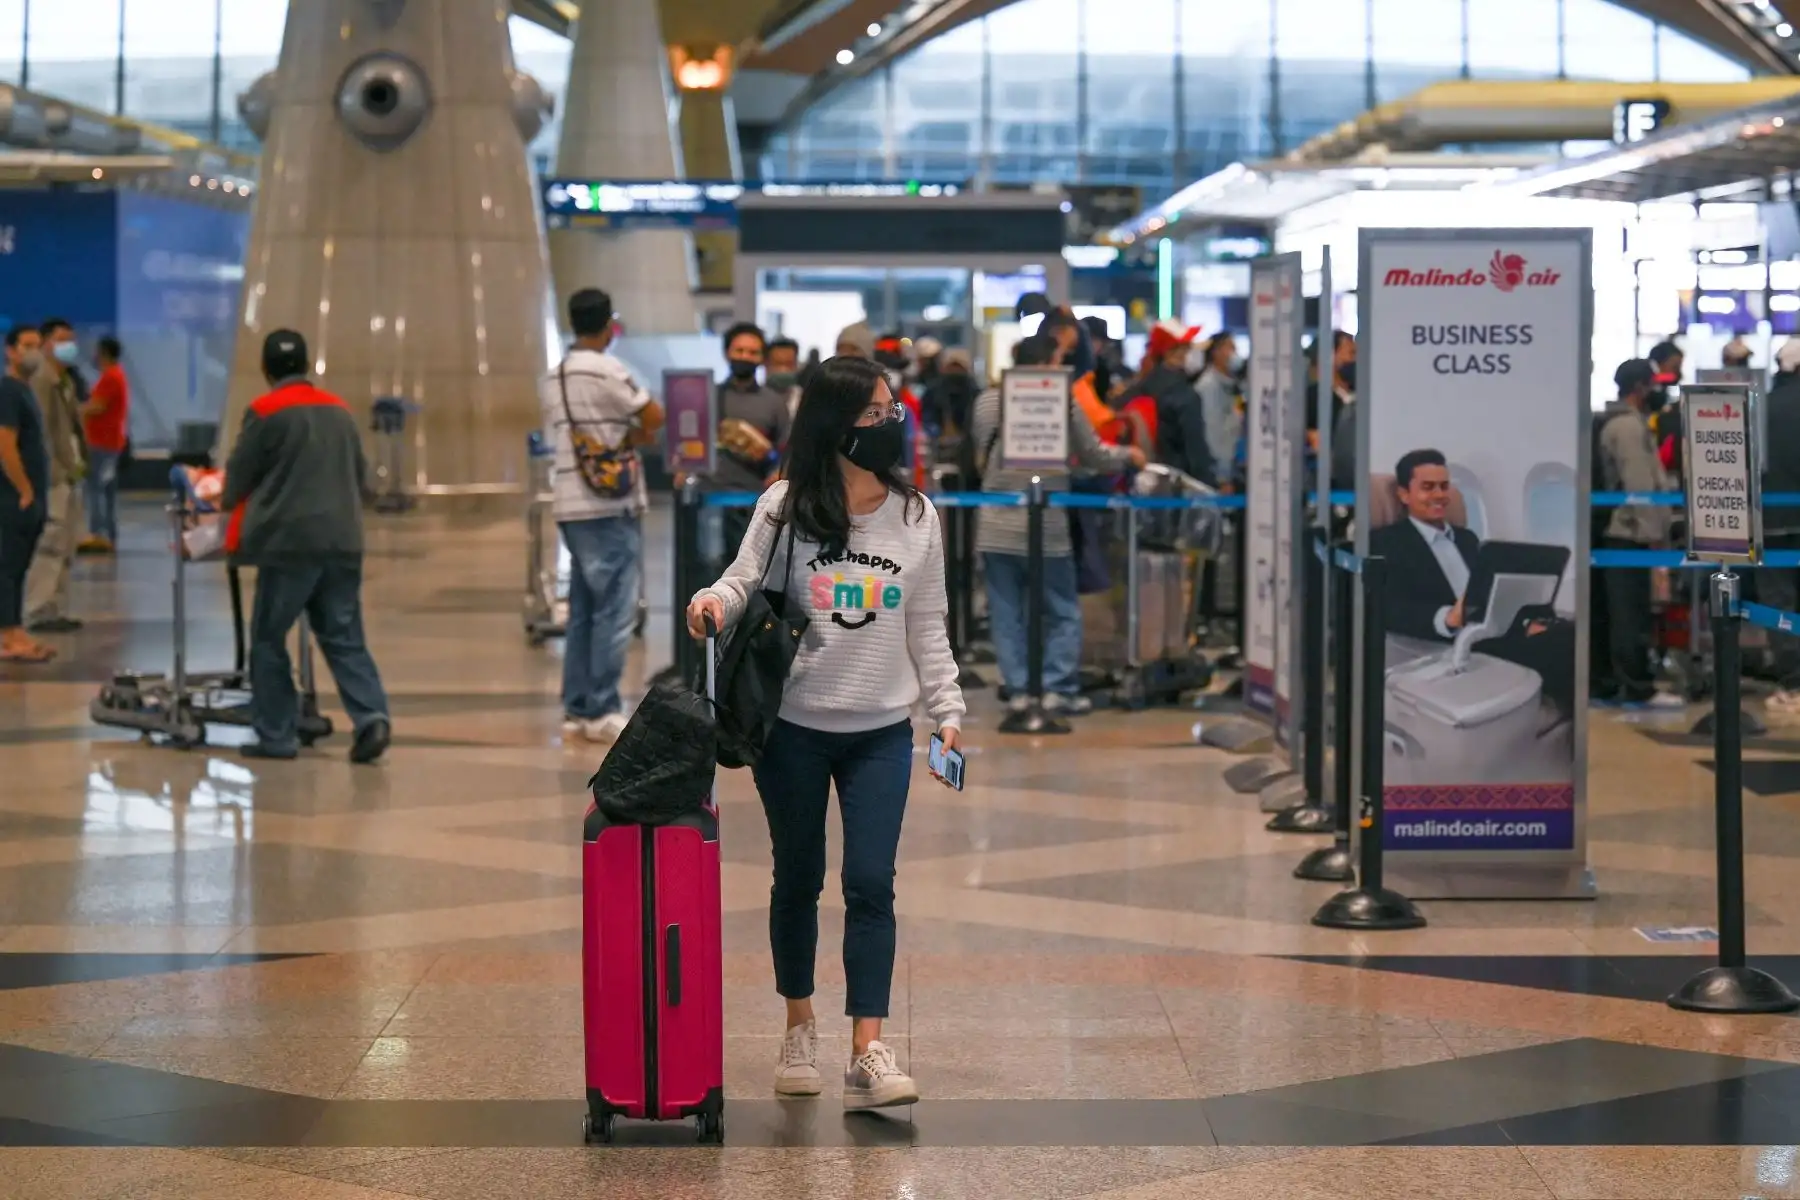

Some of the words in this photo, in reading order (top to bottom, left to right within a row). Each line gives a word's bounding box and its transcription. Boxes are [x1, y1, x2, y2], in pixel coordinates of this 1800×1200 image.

[1383, 268, 1486, 287] Malindo
[1526, 268, 1561, 286] air
[1412, 324, 1533, 345] BUSINESS
[1433, 353, 1511, 374] CLASS
[1695, 430, 1743, 445] BUSINESS
[1705, 449, 1737, 464] CLASS
[1697, 476, 1744, 492] CHECK-IN
[1697, 495, 1746, 511] COUNTER:
[1705, 514, 1716, 528] E1
[1718, 514, 1725, 529] &
[1728, 515, 1740, 529] E2
[846, 550, 902, 575] happy
[810, 572, 902, 610] Smile
[1394, 820, 1547, 838] malindoair.com
